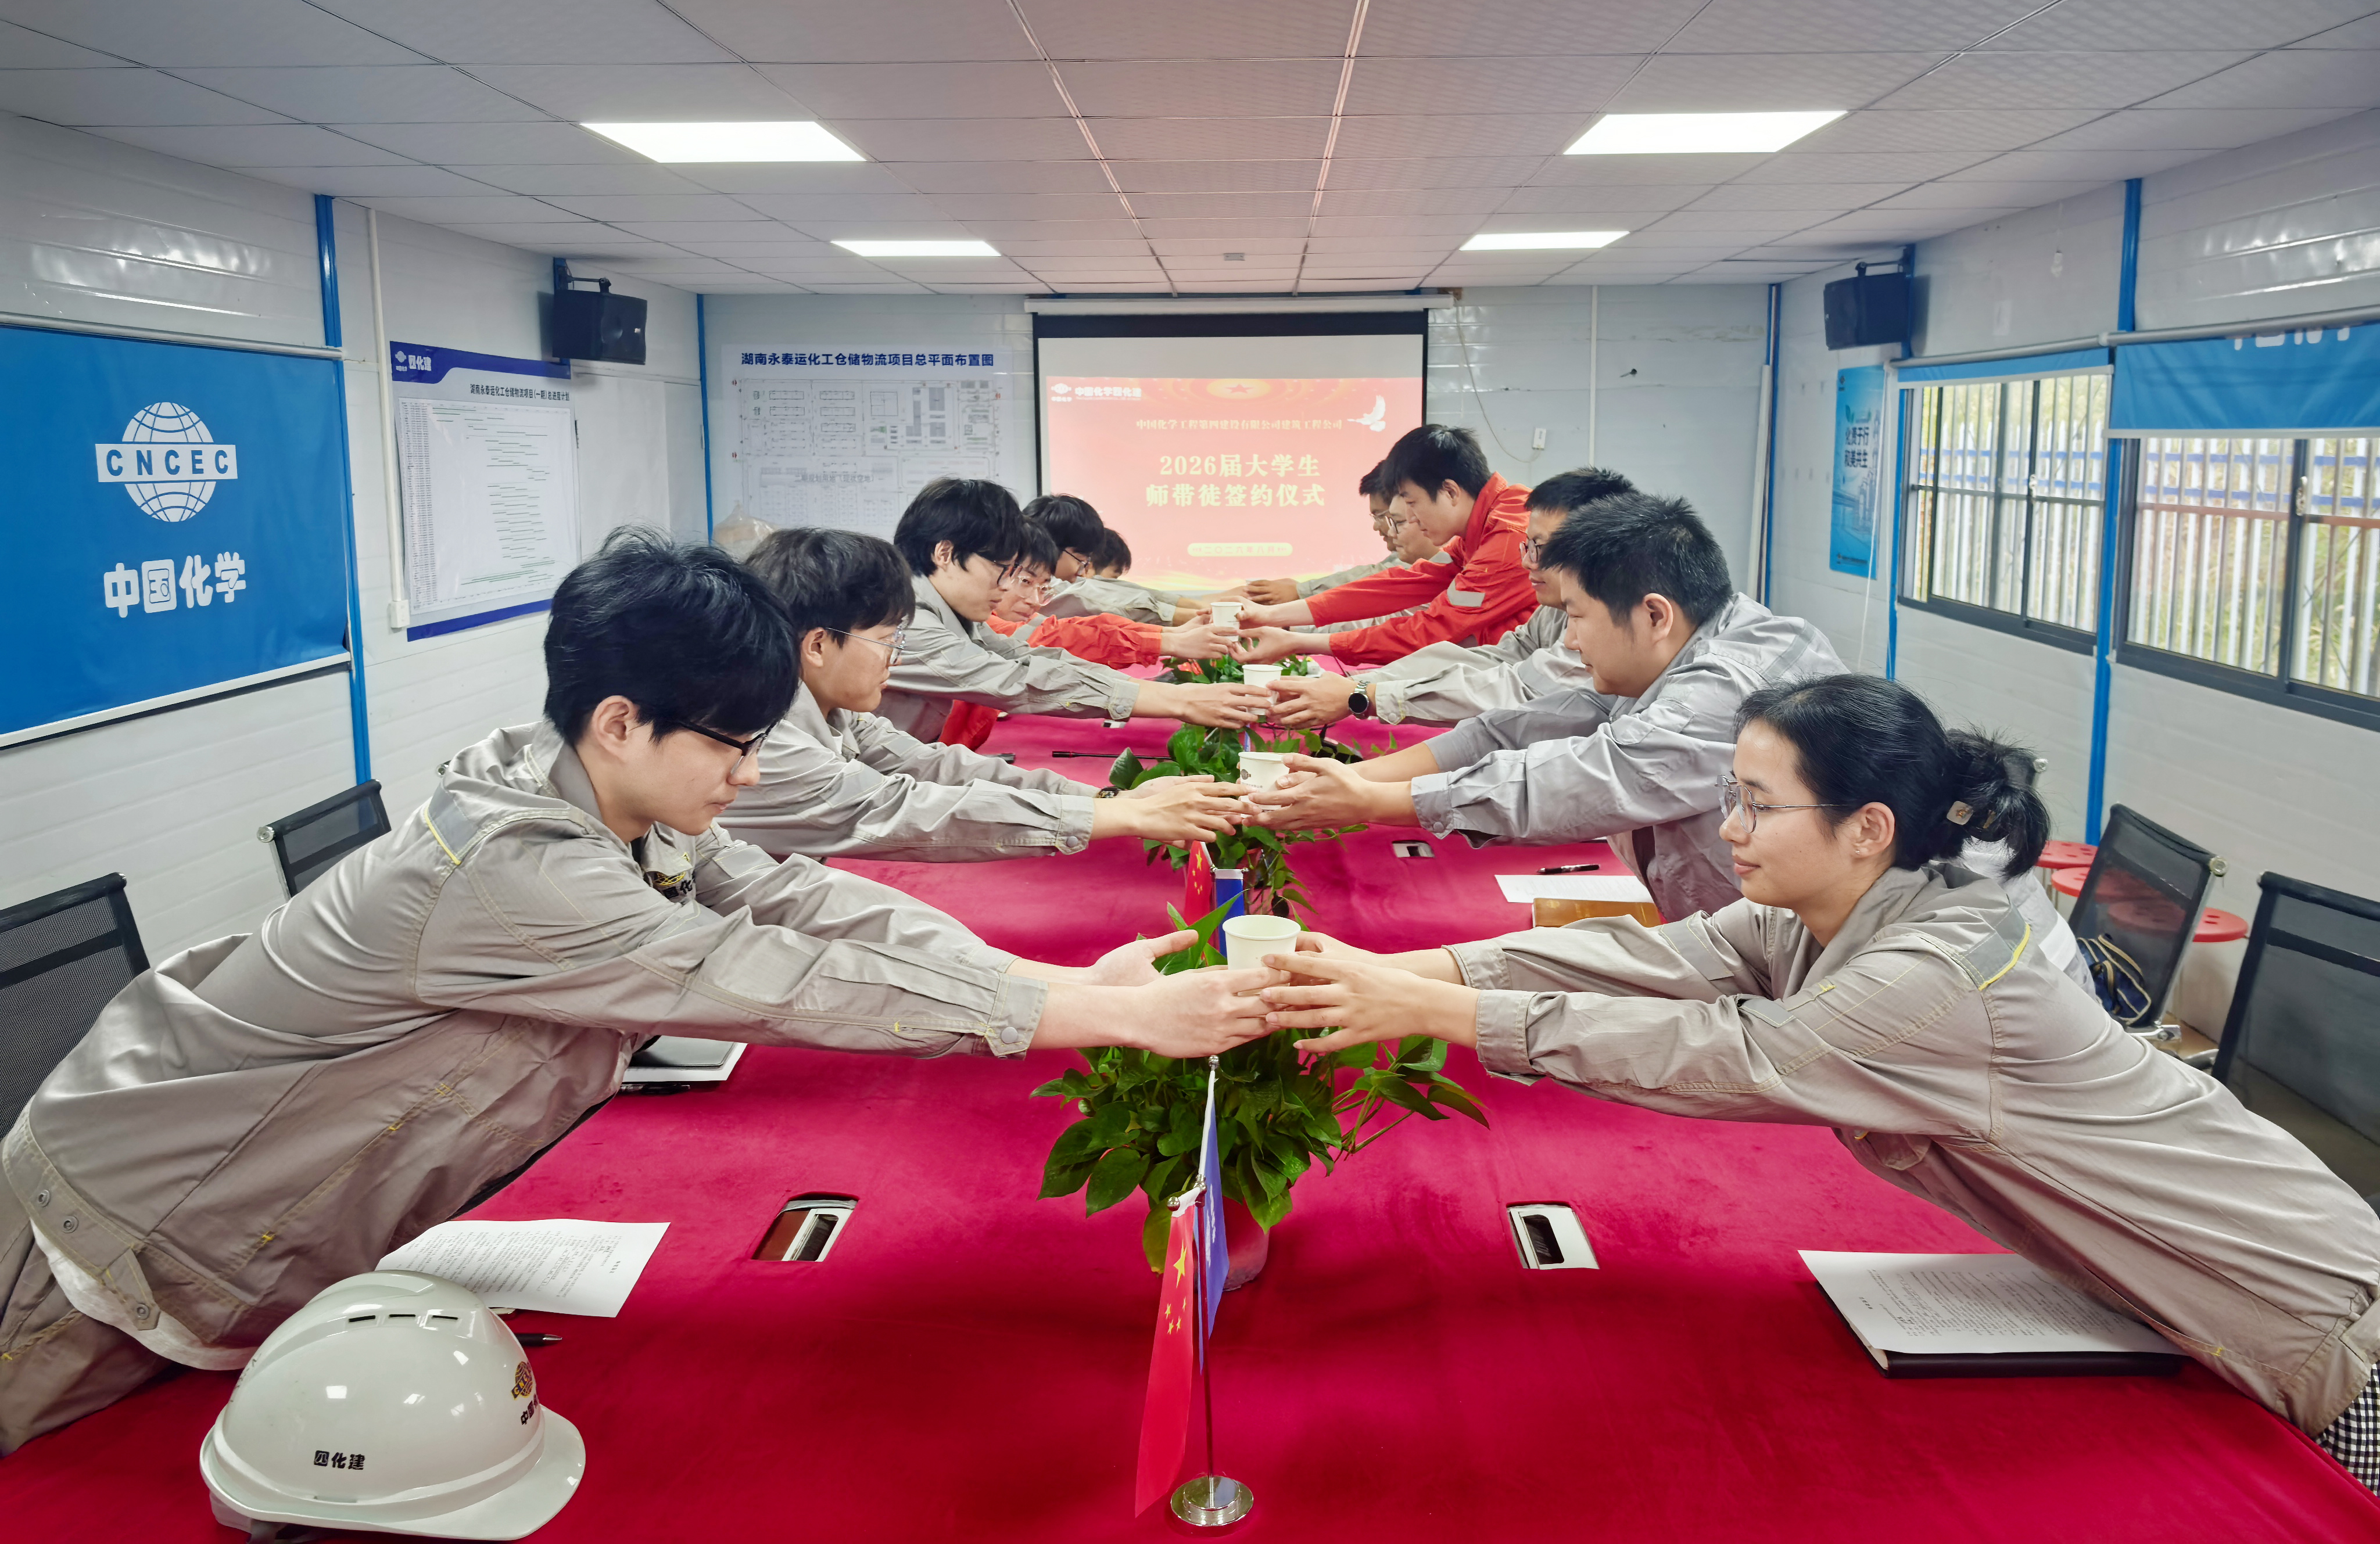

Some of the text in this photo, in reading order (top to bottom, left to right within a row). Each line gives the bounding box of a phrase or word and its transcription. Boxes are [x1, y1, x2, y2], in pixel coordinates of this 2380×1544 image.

[741, 353, 994, 367] 湖南永泰运化工仓储物流项目总平面布置图
[106, 449, 228, 476] CNCEC
[1160, 454, 1321, 477] 2026届大学生
[1146, 483, 1325, 507] 师带徒签约仪式
[103, 551, 246, 618] 中国化学
[314, 1450, 365, 1470] 四化建
